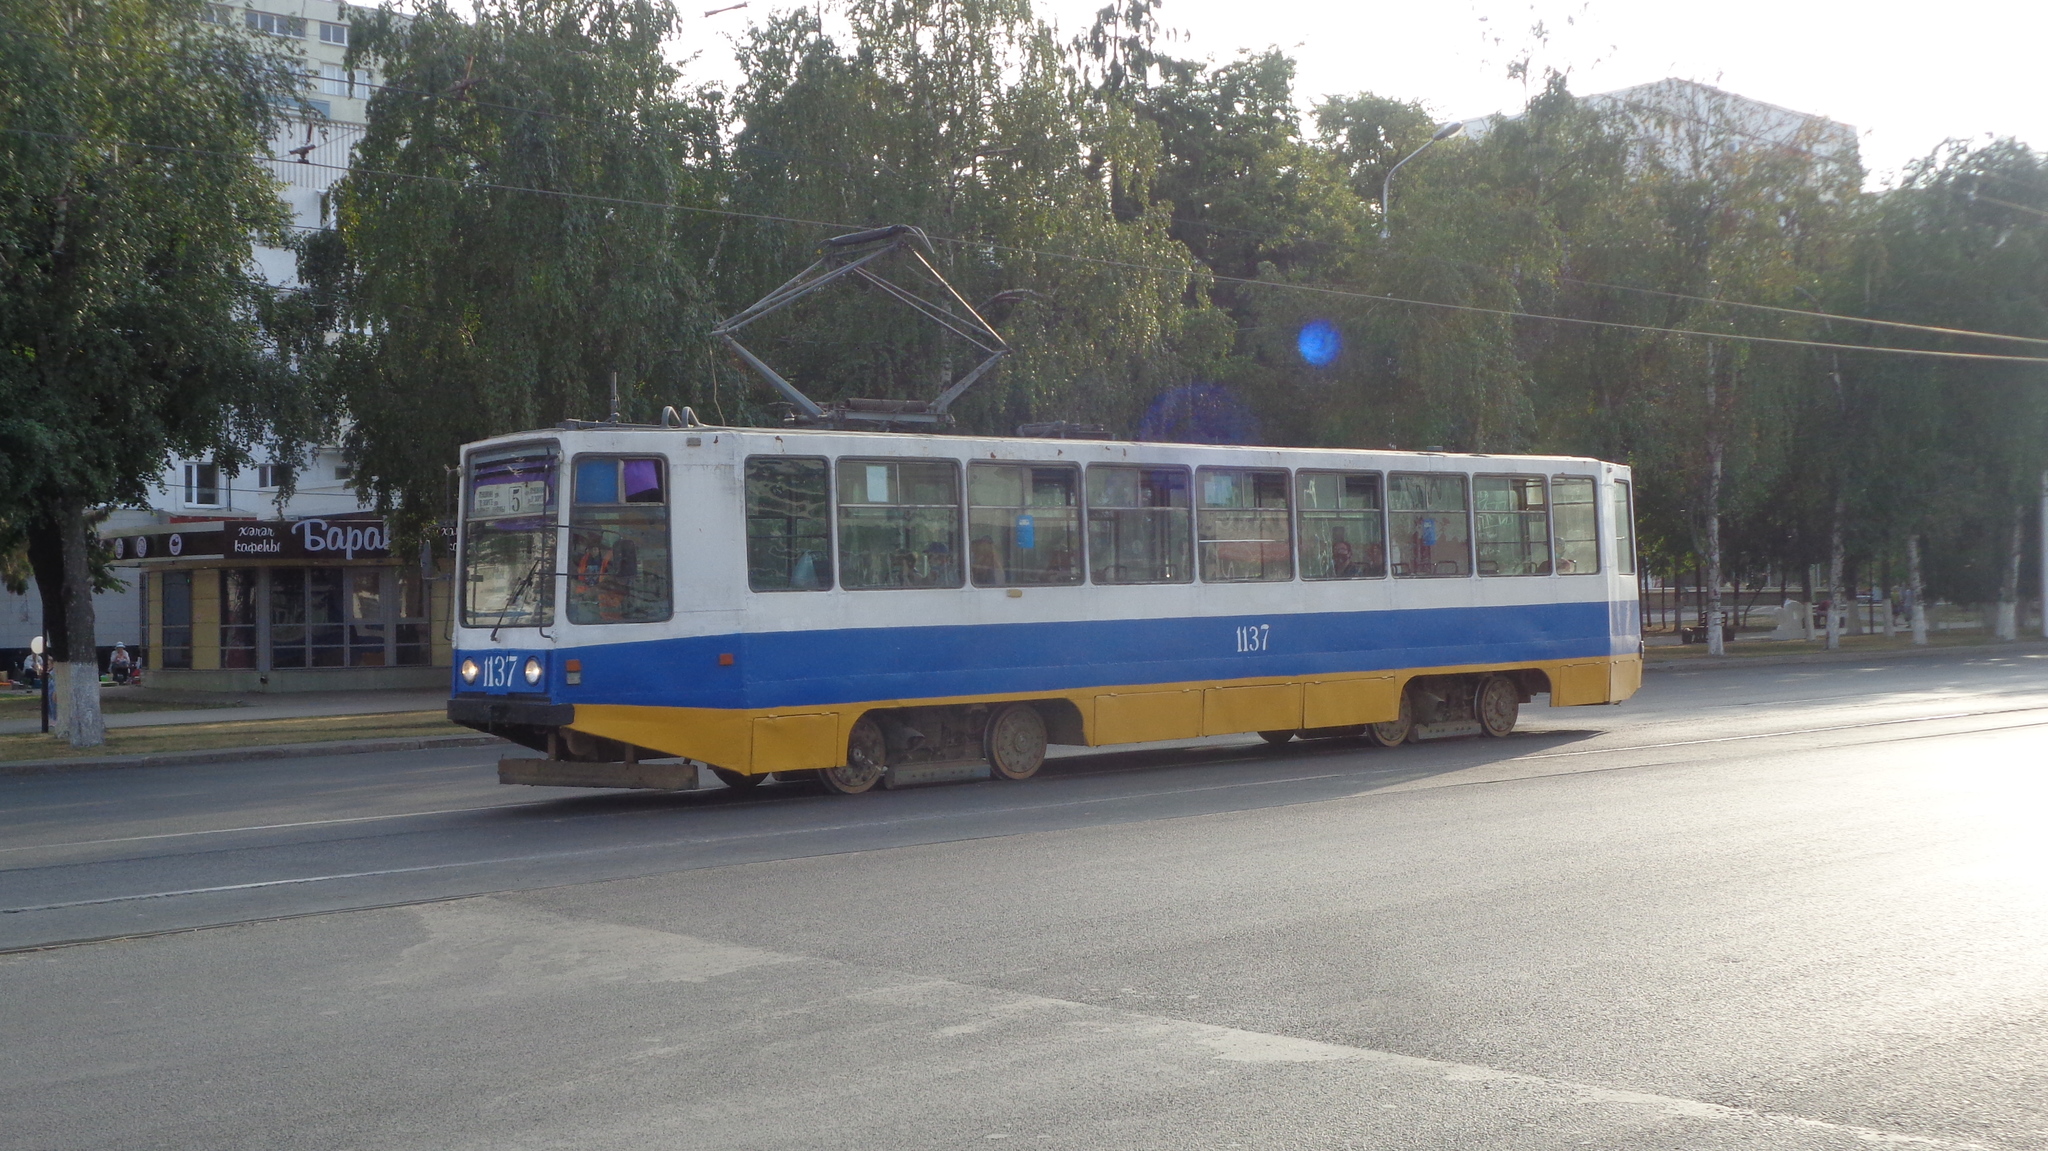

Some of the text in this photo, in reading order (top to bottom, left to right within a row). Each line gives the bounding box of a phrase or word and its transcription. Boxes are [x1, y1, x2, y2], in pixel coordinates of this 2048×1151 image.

[511, 488, 521, 512] 5
[1236, 624, 1270, 652] 1137
[483, 656, 518, 687] 1137
